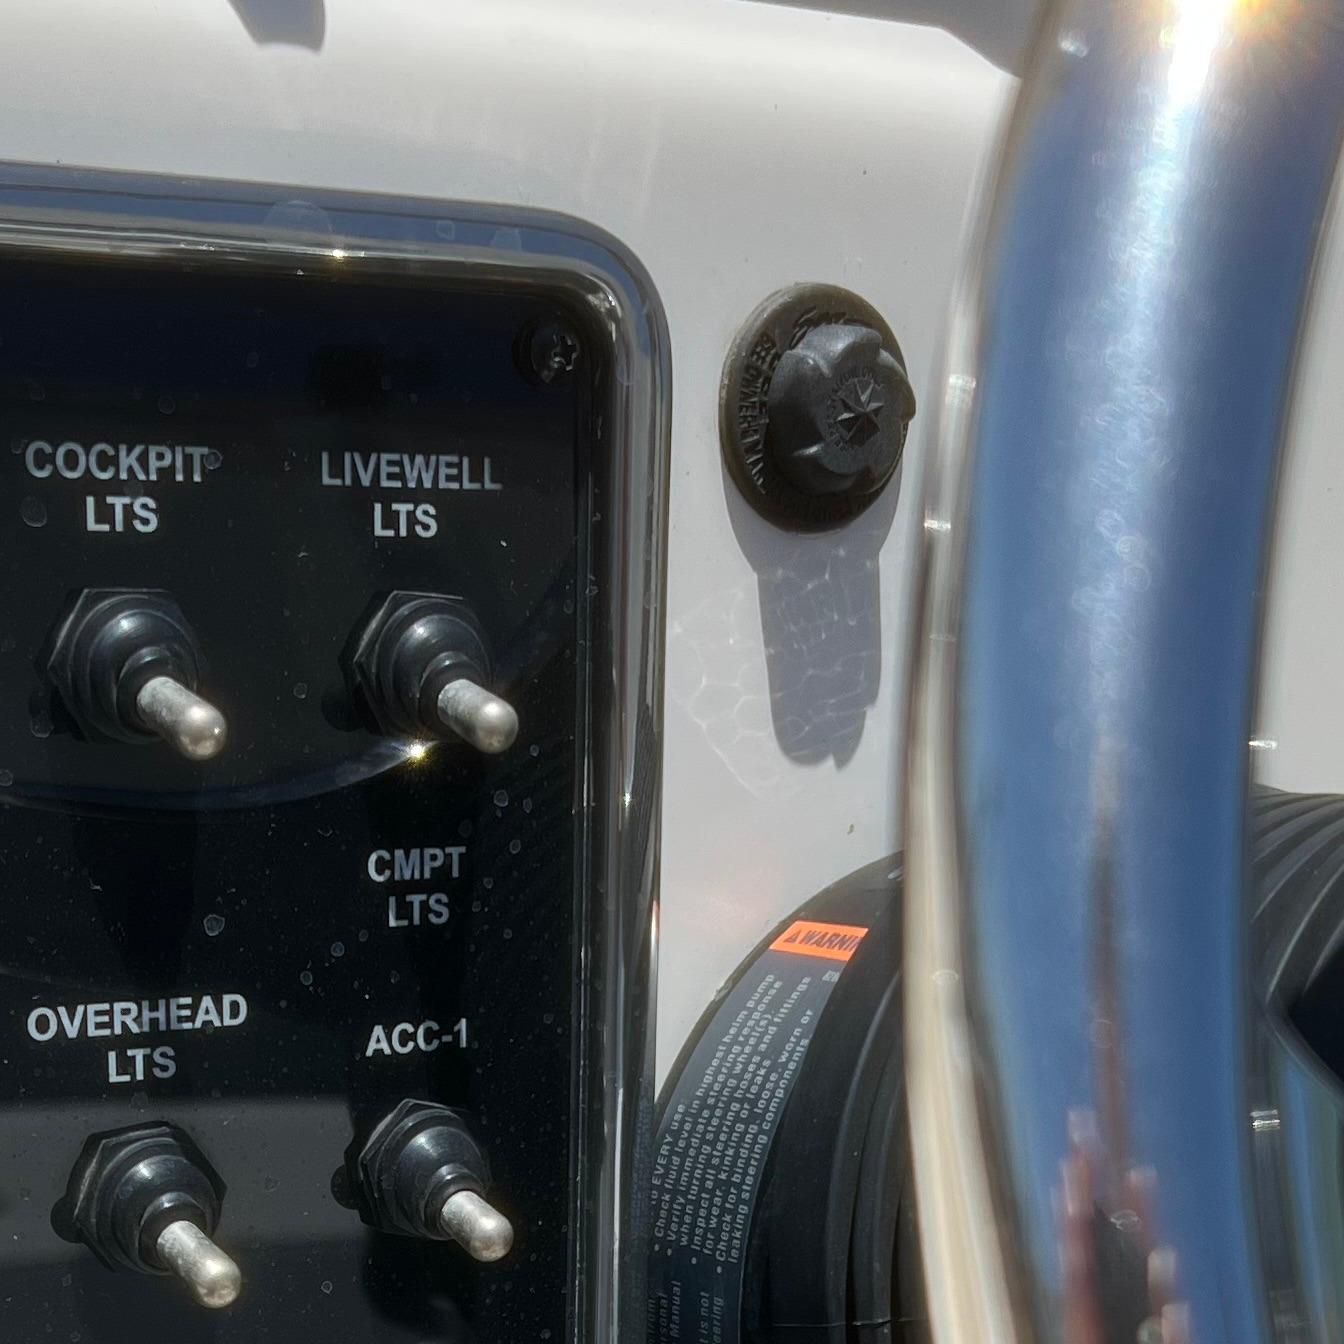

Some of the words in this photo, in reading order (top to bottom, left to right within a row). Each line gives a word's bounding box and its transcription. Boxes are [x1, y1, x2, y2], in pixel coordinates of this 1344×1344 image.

[24, 440, 207, 483] COCKPIT
[320, 450, 503, 493] LIVEWELL
[85, 495, 160, 535] LTS
[372, 501, 439, 540] LTS
[367, 845, 467, 883] CMPT
[388, 890, 449, 928] LTS
[798, 928, 864, 952] WARNIN
[746, 974, 775, 1008] pump
[26, 992, 249, 1043] OVERHEAD
[365, 1018, 469, 1057] ACC-1
[721, 1010, 748, 1043] helm
[107, 1046, 178, 1084] LTS
[694, 1045, 727, 1097] highest
[666, 1195, 686, 1241] Verify
[678, 1109, 710, 1191] immediate
[706, 1045, 742, 1105] steering
[737, 980, 783, 1042] response
[689, 1099, 701, 1113] in
[690, 1192, 711, 1251] Inspect
[704, 1168, 716, 1189] all
[711, 1102, 741, 1166] steering
[733, 1055, 761, 1098] hoses
[758, 1025, 778, 1052] and
[773, 976, 812, 1023] fittings
[651, 1133, 673, 1186] EVERY
[670, 1103, 686, 1130] use
[674, 1116, 693, 1153] level
[715, 1213, 732, 1262] Check
[724, 1186, 738, 1209] for
[777, 1027, 803, 1063] worn
[800, 1009, 814, 1024] or
[663, 1155, 681, 1189] fluid
[679, 1204, 694, 1246] when
[687, 1144, 712, 1200] turning
[705, 1078, 738, 1141] steering
[702, 1232, 715, 1255] for
[717, 1122, 746, 1180] kinking
[739, 1102, 751, 1119] or
[654, 1193, 671, 1238] Check
[727, 1204, 749, 1263] leaking
[741, 1134, 769, 1200] steering
[669, 1280, 682, 1338] Manual
[699, 1291, 710, 1317] not
